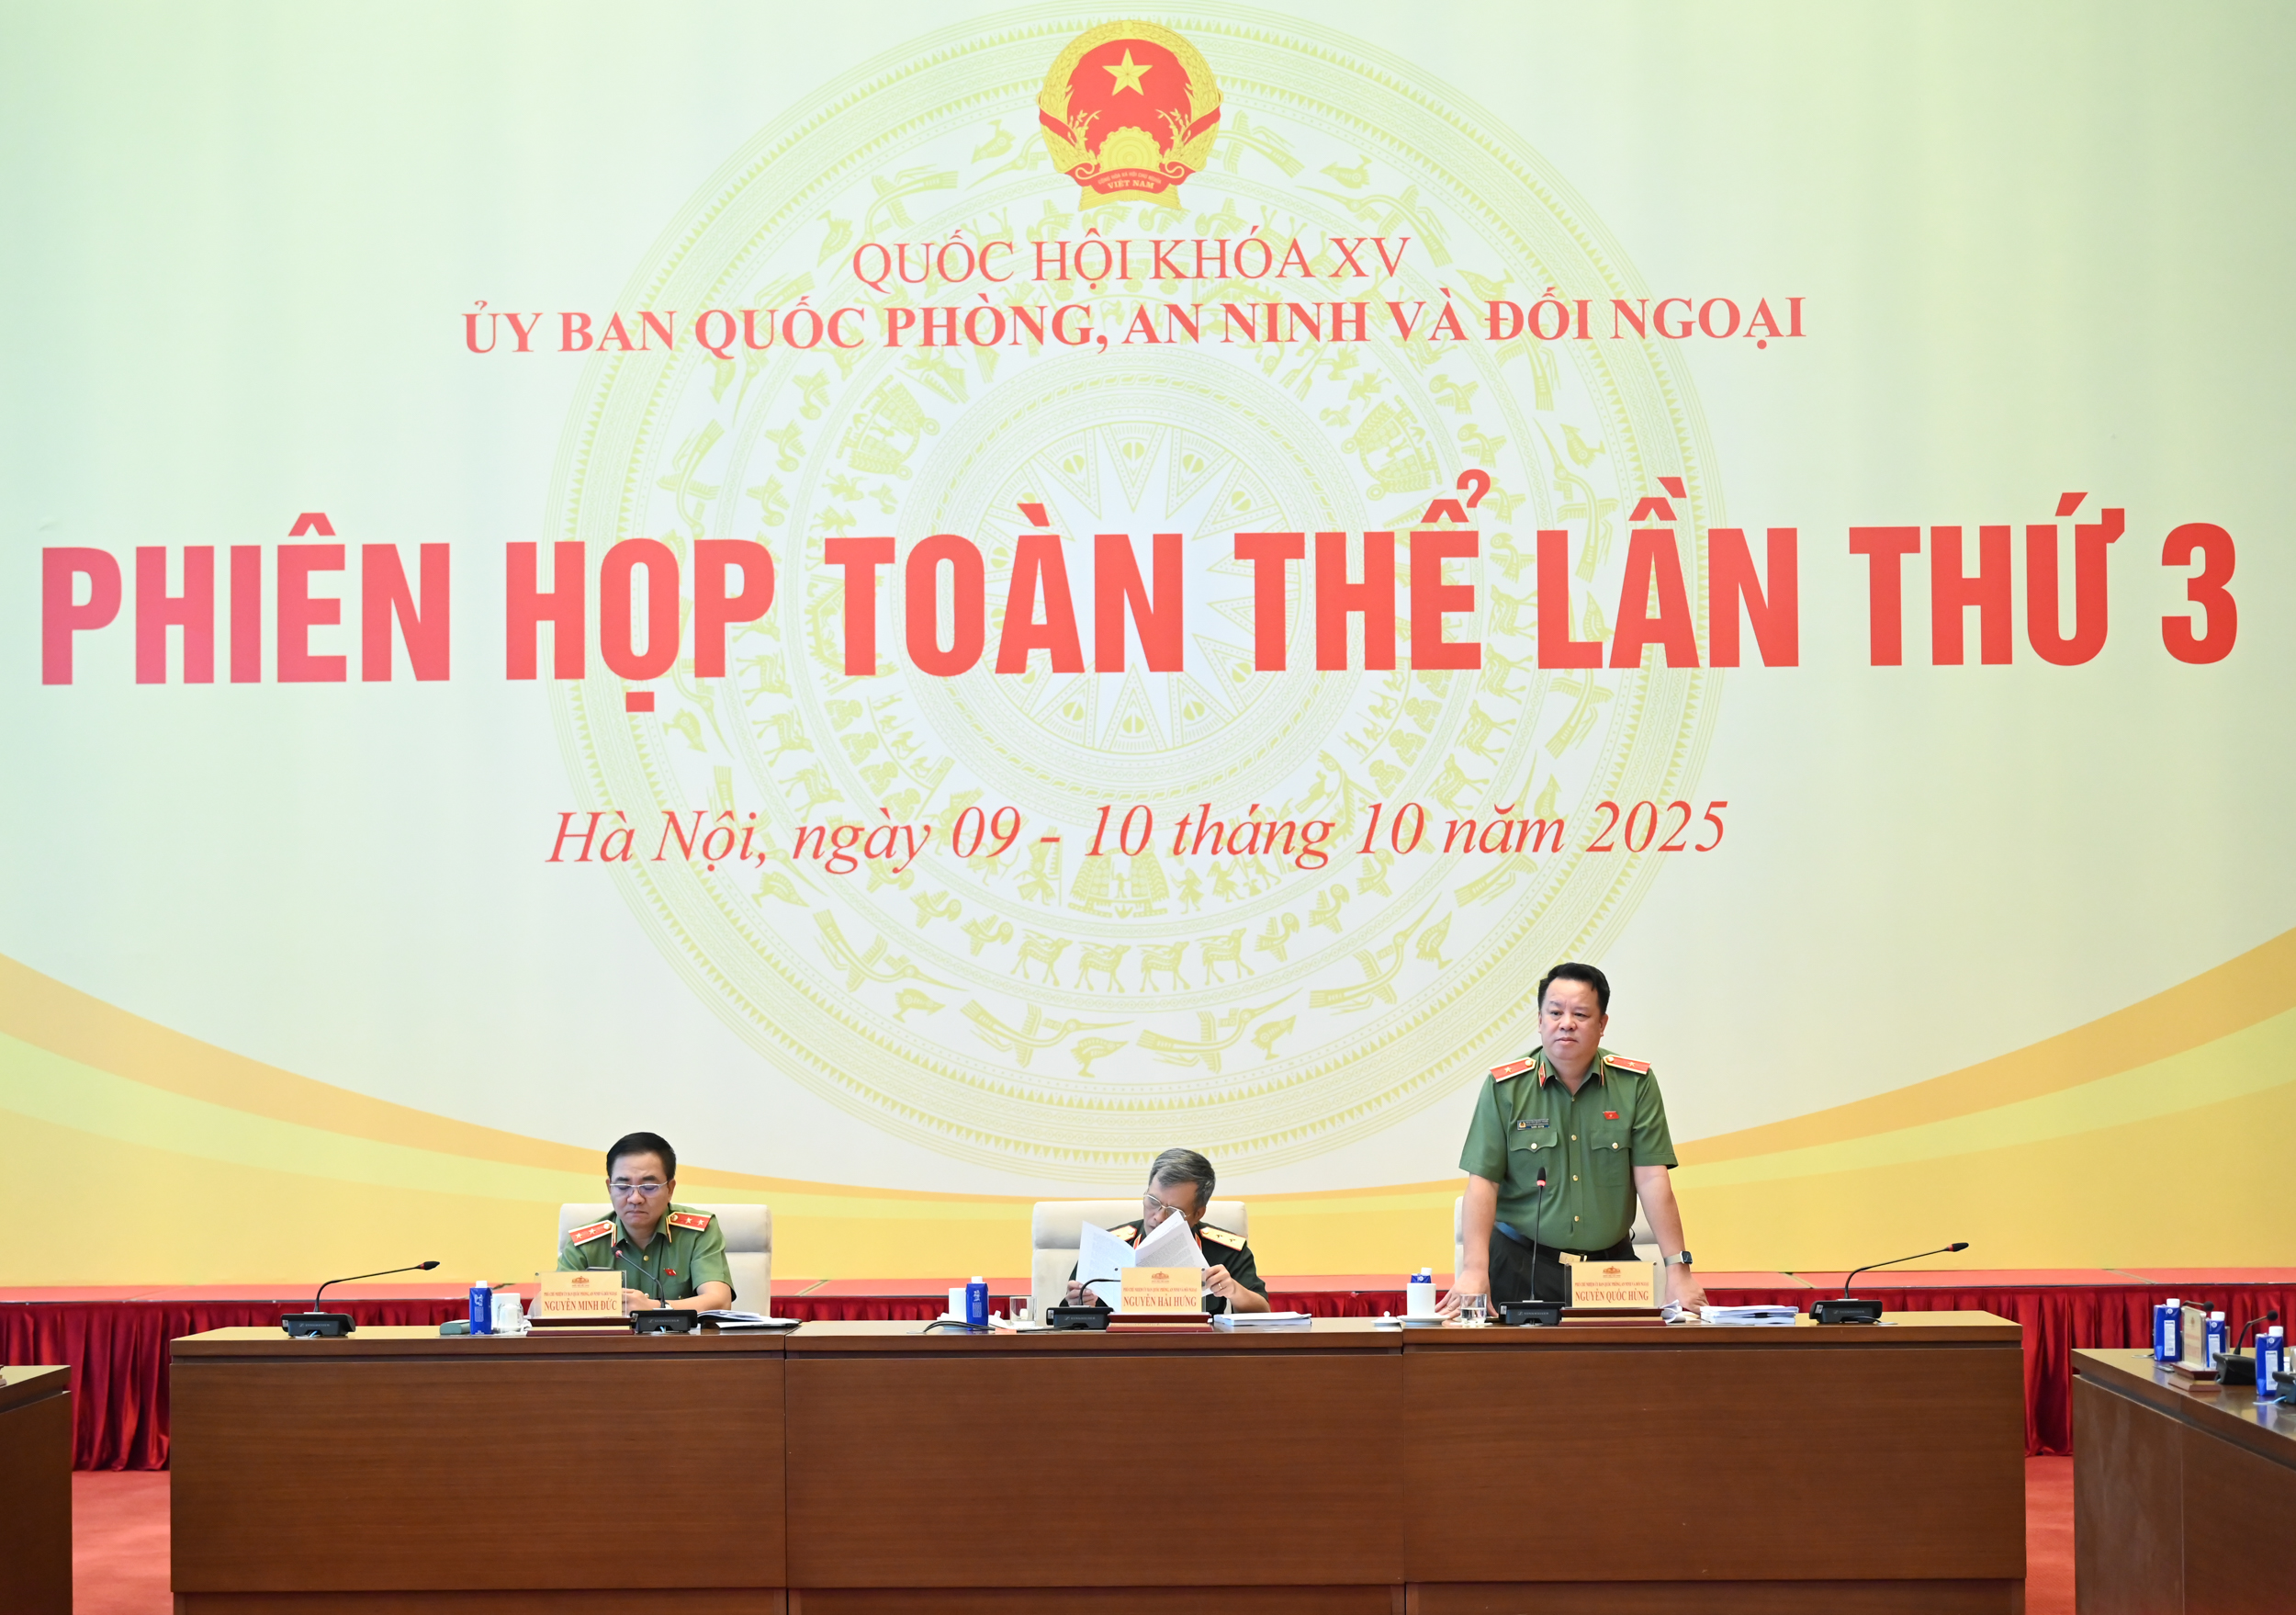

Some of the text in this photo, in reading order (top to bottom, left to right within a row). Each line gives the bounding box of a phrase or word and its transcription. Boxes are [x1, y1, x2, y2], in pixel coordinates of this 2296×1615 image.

[1108, 179, 1154, 189] VIỆT NAM
[853, 224, 1412, 294] QUỐC HỘI KHÓA XV
[463, 287, 1806, 359] ỦY BAN QUỐC PHÒNG, AN NINH VÀ ĐỐI NGOẠI
[41, 469, 2238, 714] PHIÊN HỌP TOÀN THỂ LẦN THỨ 3
[545, 809, 636, 863] Hà
[651, 809, 767, 872] Nội,
[793, 807, 932, 875] ngày
[952, 806, 1021, 858] 09
[1085, 804, 1154, 857] 10
[1173, 802, 1336, 871] tháng
[1356, 802, 1425, 854] 10
[1443, 803, 1566, 854] năm
[1585, 799, 1728, 853] 2025
[544, 1297, 618, 1311] NGUYỄN MINH ĐỨC
[1123, 1293, 1156, 1307] NGUYỄN
[1174, 1295, 1197, 1307] HƯNG
[1575, 1287, 1649, 1303] NGUYỄN QUỐC HÙNG
